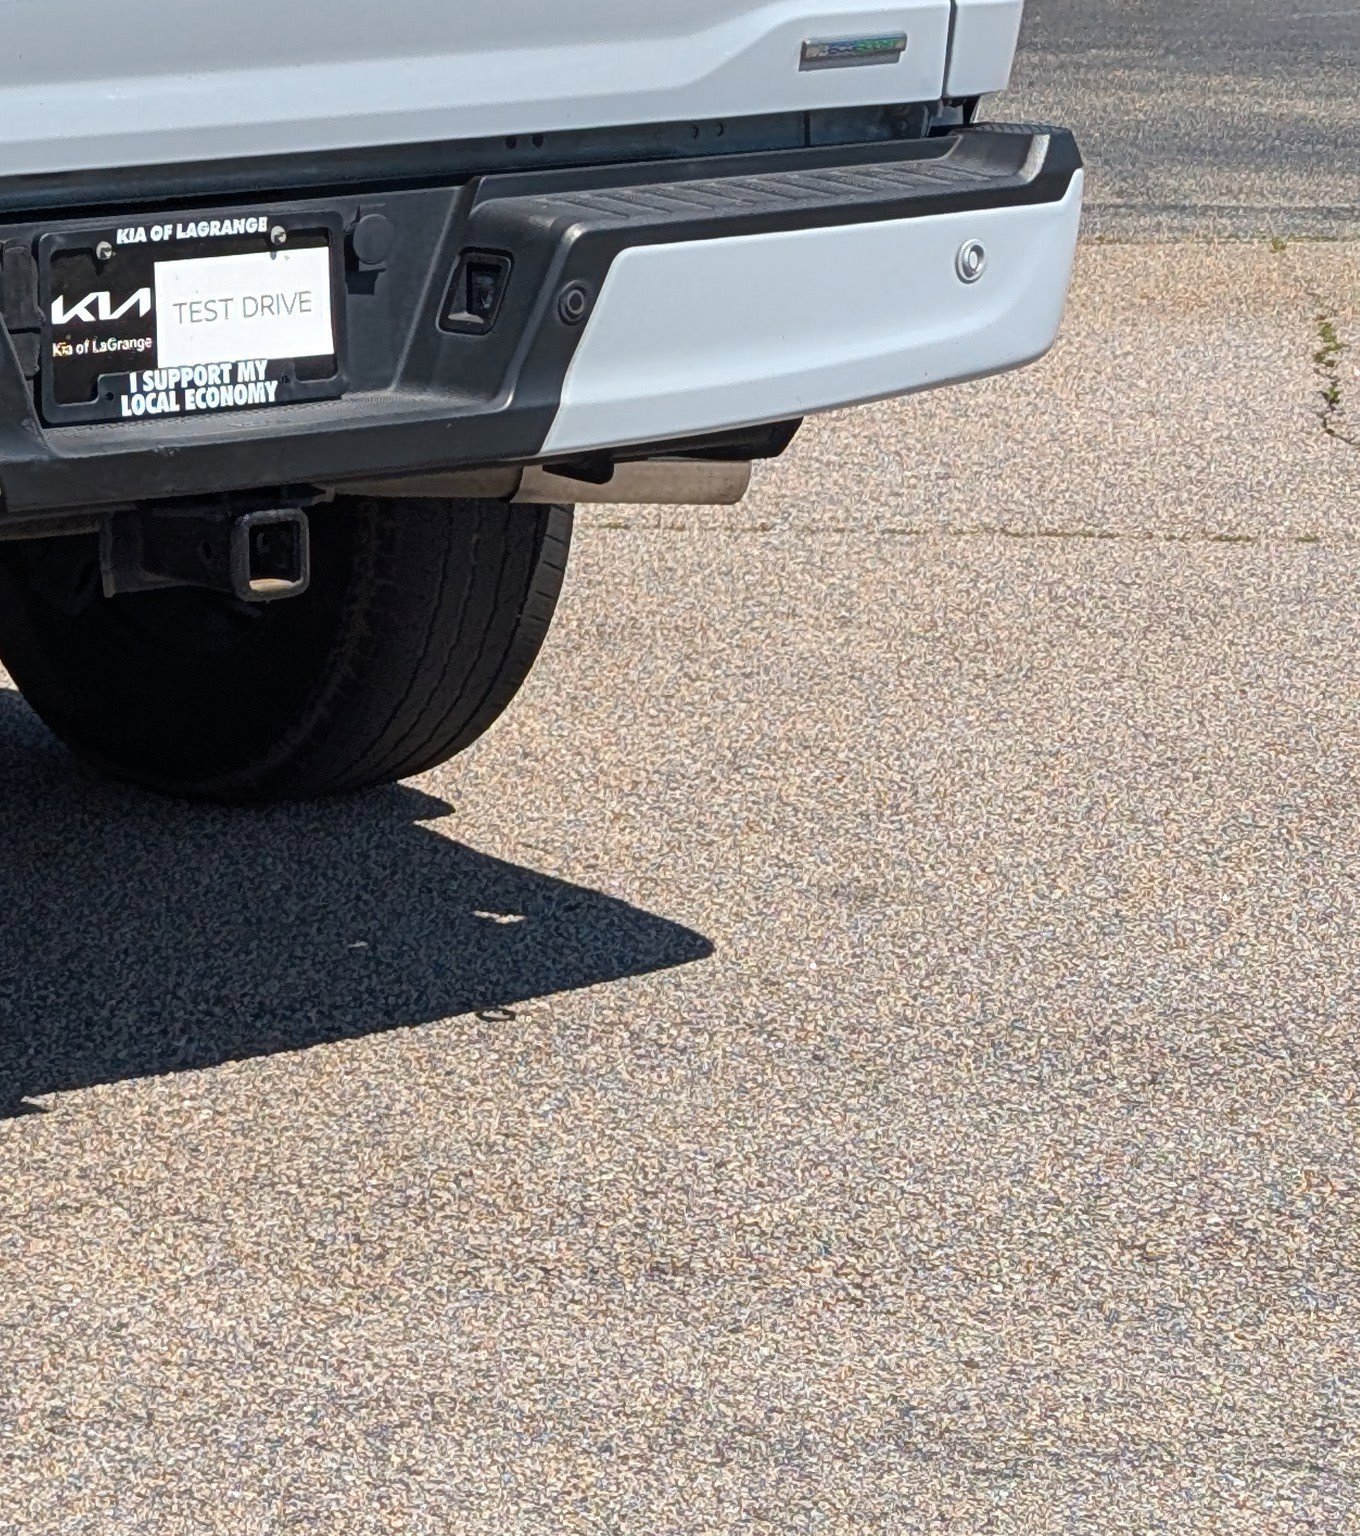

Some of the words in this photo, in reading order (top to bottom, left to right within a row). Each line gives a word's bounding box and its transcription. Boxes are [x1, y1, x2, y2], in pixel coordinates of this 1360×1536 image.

[116, 226, 147, 245] KIA
[150, 224, 173, 242] OF
[176, 216, 268, 240] LAGRANGE
[172, 297, 234, 324] TEST
[242, 290, 312, 319] DRIVE
[52, 341, 74, 358] Kia
[75, 338, 89, 355] of
[91, 336, 153, 353] LaGrange
[129, 371, 138, 393] I
[142, 362, 232, 392] SUPPORT
[237, 359, 268, 383] MY
[120, 389, 180, 417] LOCAL
[184, 380, 279, 411] ECONOMY
